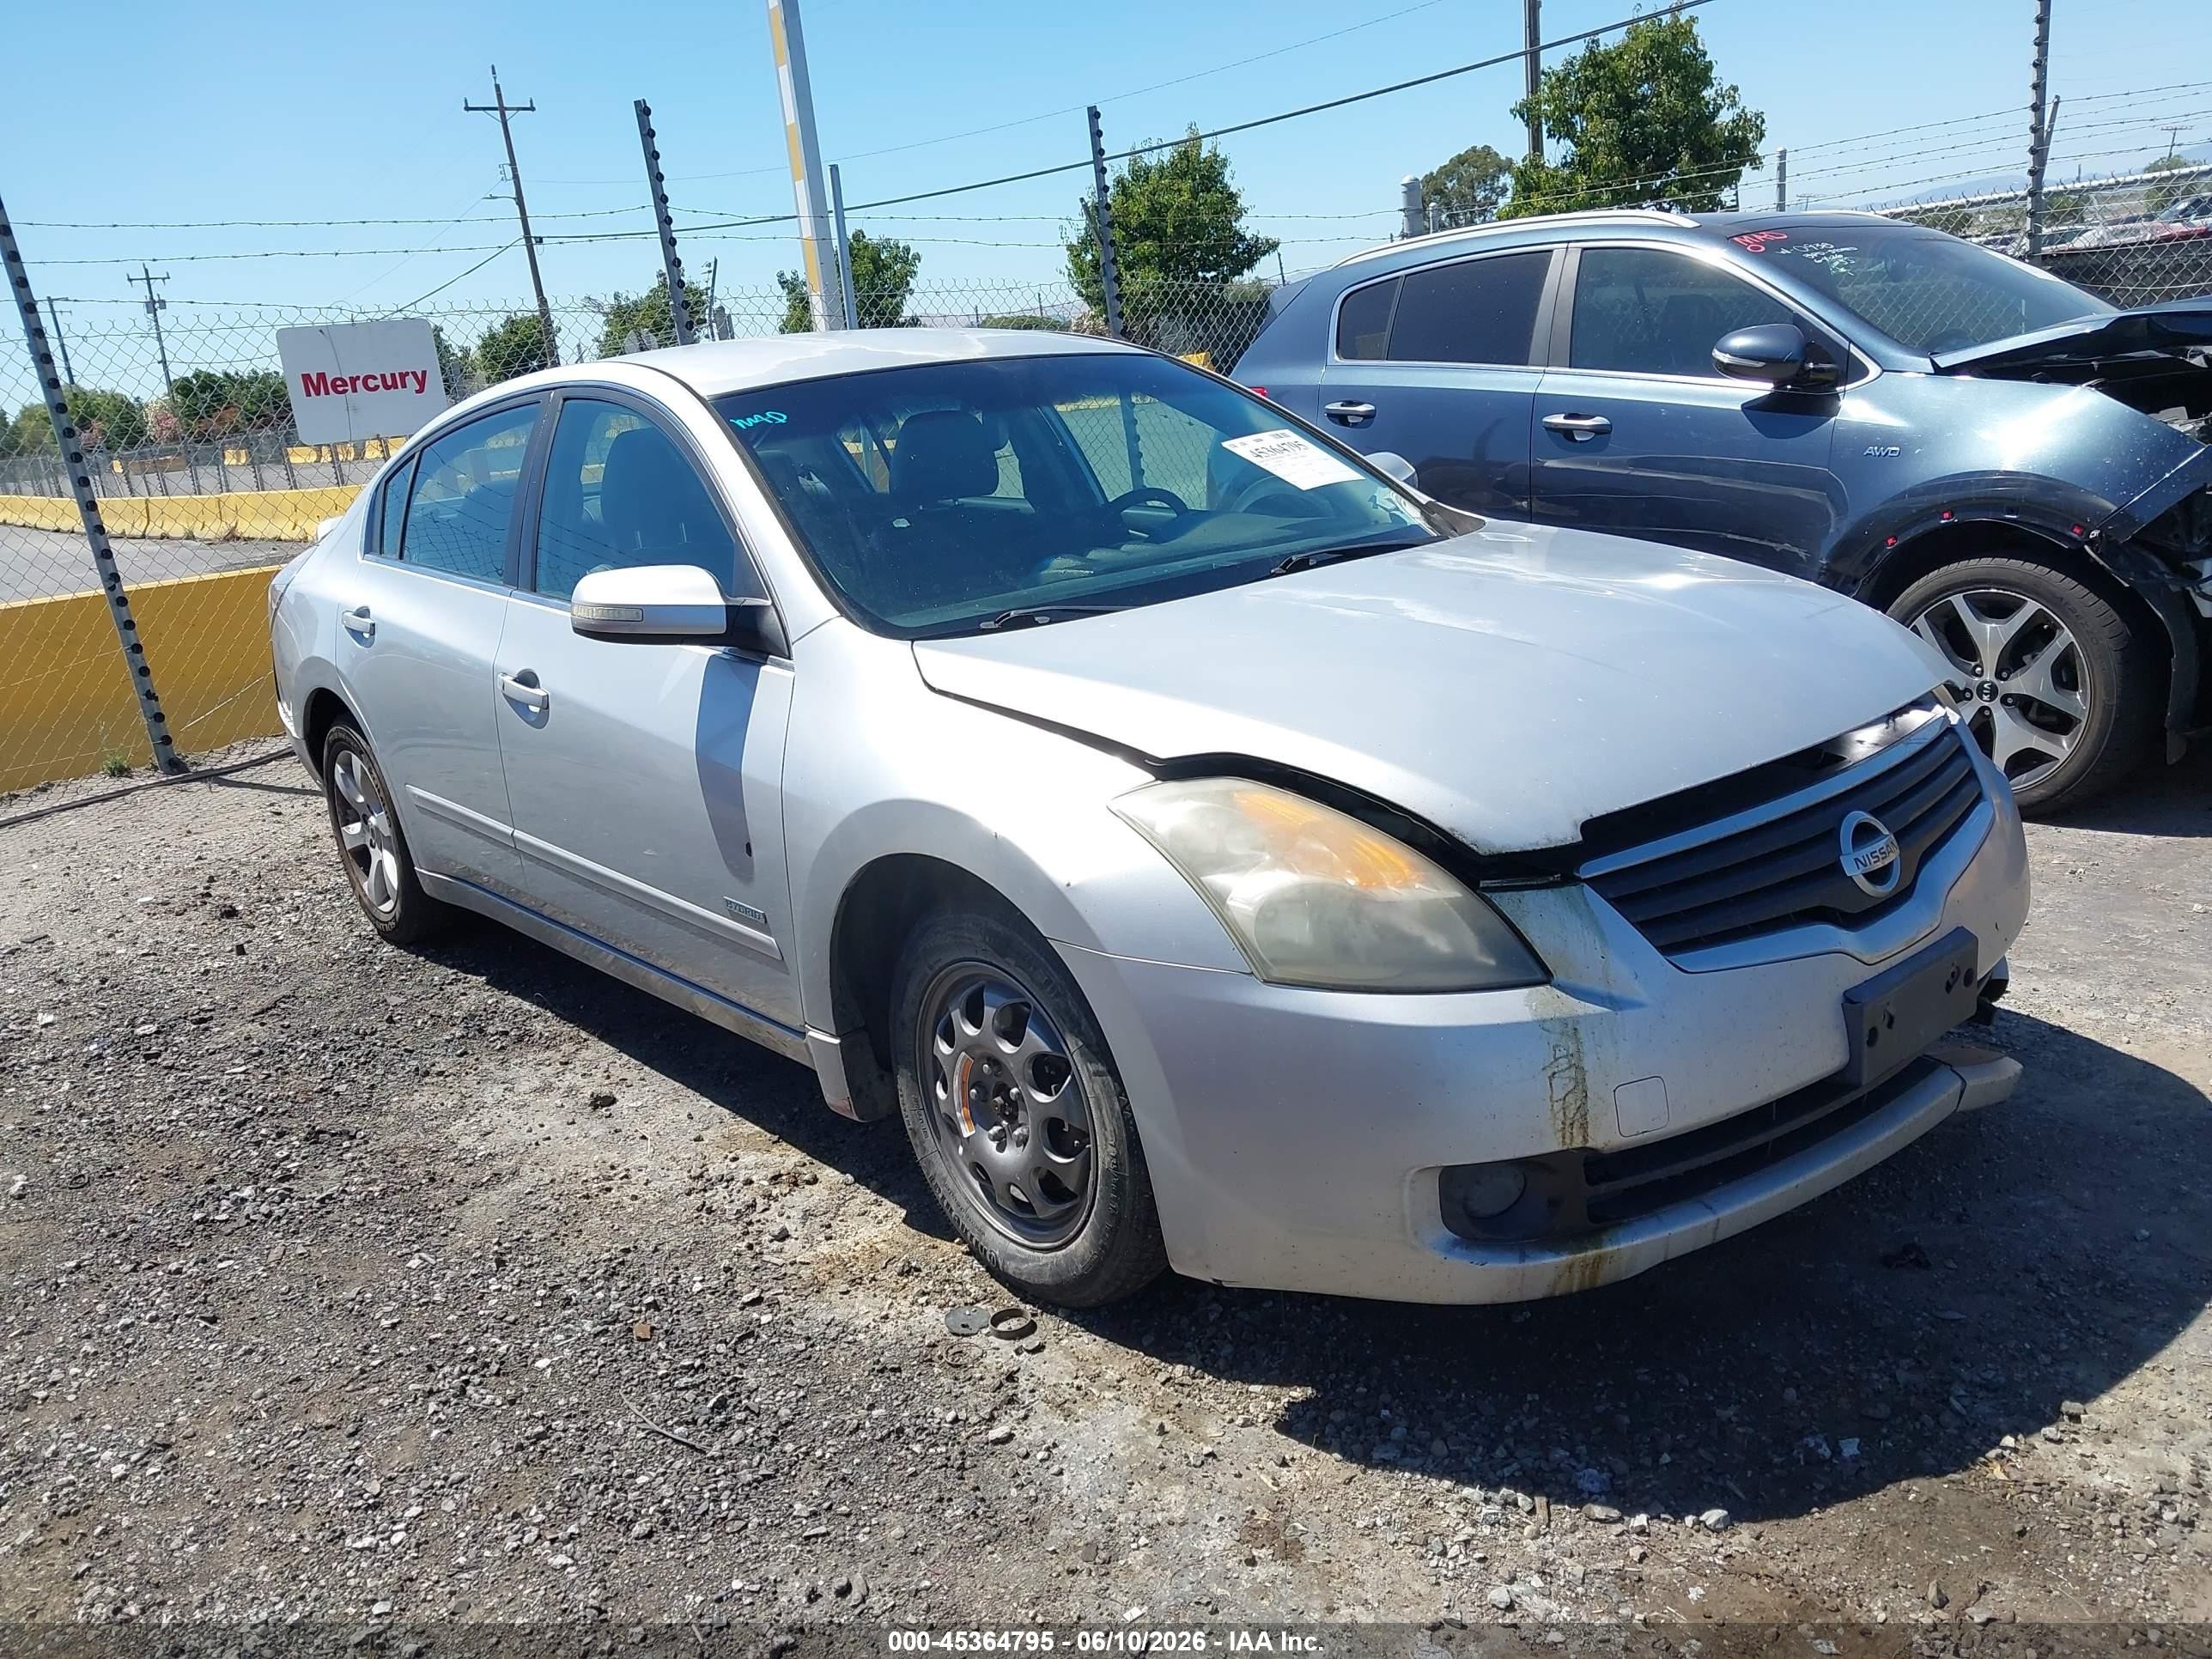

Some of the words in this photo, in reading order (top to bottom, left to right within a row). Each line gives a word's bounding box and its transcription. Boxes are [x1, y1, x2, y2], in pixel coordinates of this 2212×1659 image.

[301, 369, 428, 398] Mercury
[1863, 446, 1900, 457] AWD
[1982, 683, 1992, 701] KIA
[1853, 841, 1898, 871] NISSAN
